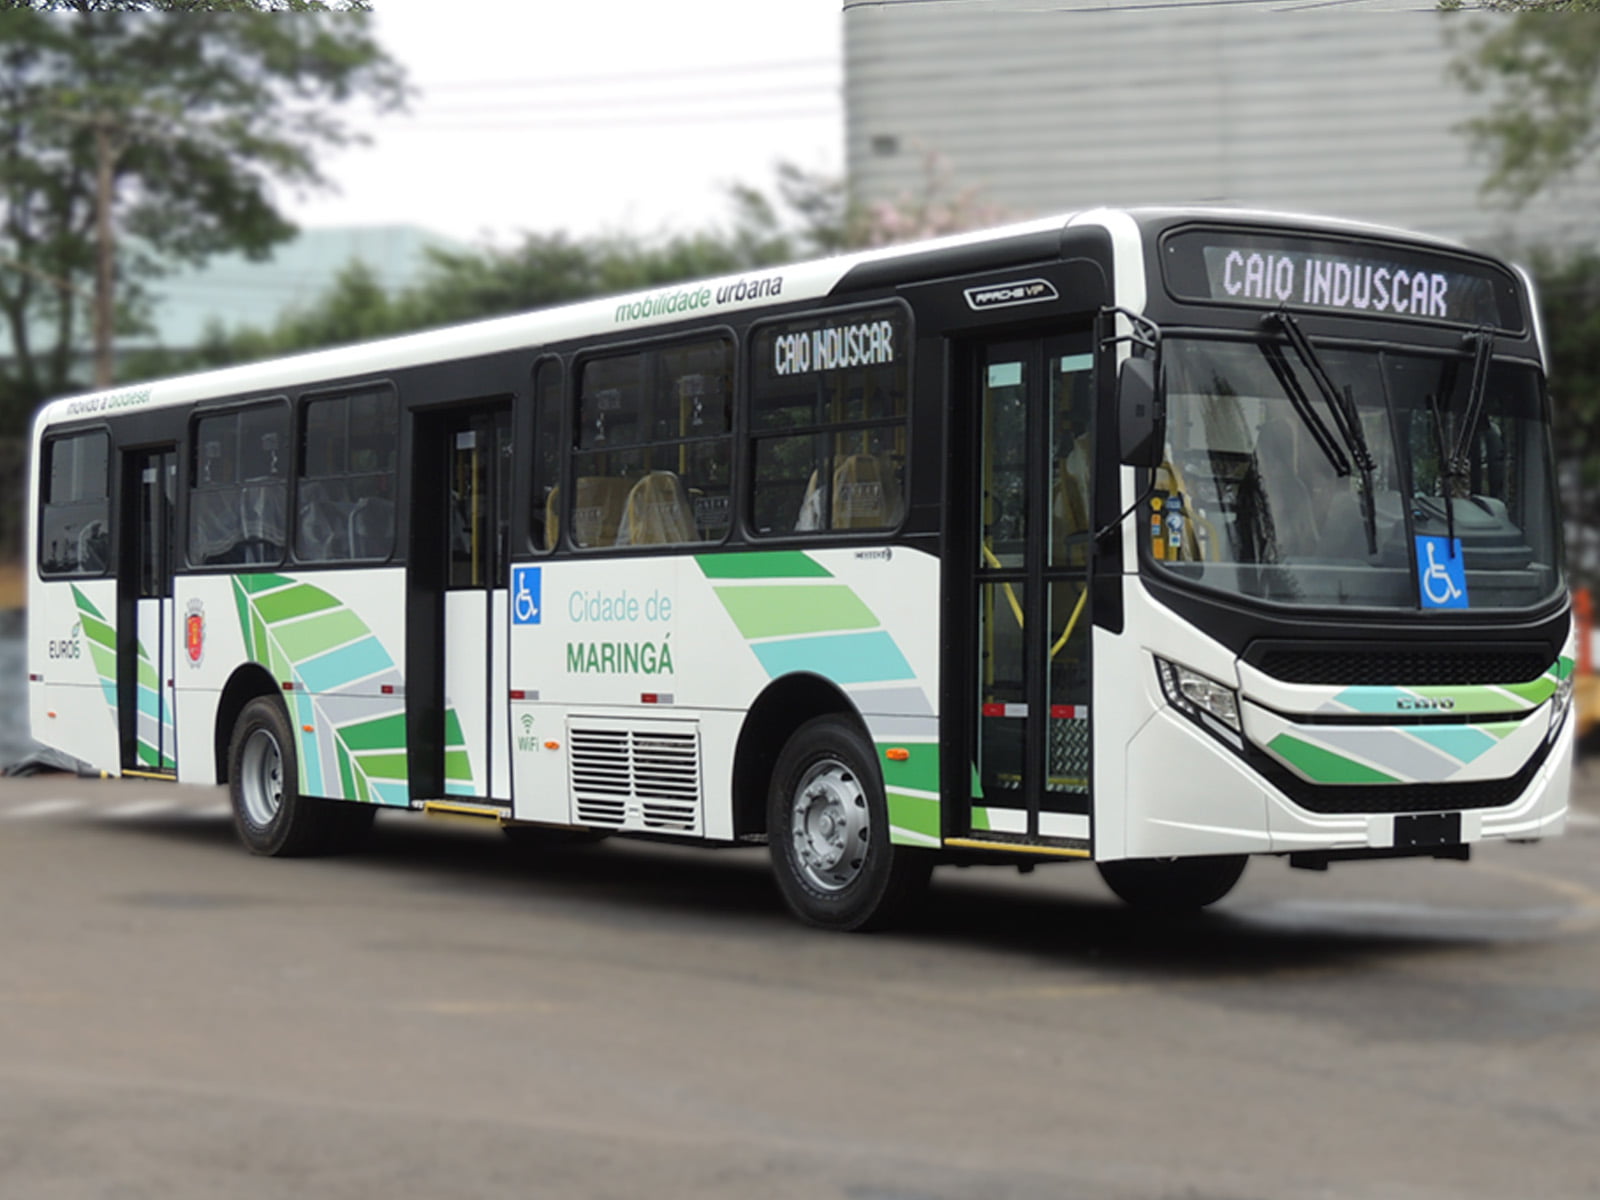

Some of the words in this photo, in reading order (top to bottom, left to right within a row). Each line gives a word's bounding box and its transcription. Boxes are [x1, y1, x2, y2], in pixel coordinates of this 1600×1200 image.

[615, 288, 712, 323] mobilidade
[716, 276, 783, 305] urbana
[1223, 250, 1294, 301] CAIO
[1303, 259, 1448, 318] INDUSCAR
[775, 332, 810, 375] CAIO
[813, 320, 893, 371] INDUSCAR
[568, 589, 640, 623] Cidade
[644, 589, 672, 622] de
[48, 639, 80, 659] EURO6
[566, 631, 674, 675] MARINGÁ
[1397, 697, 1454, 709] CAIO
